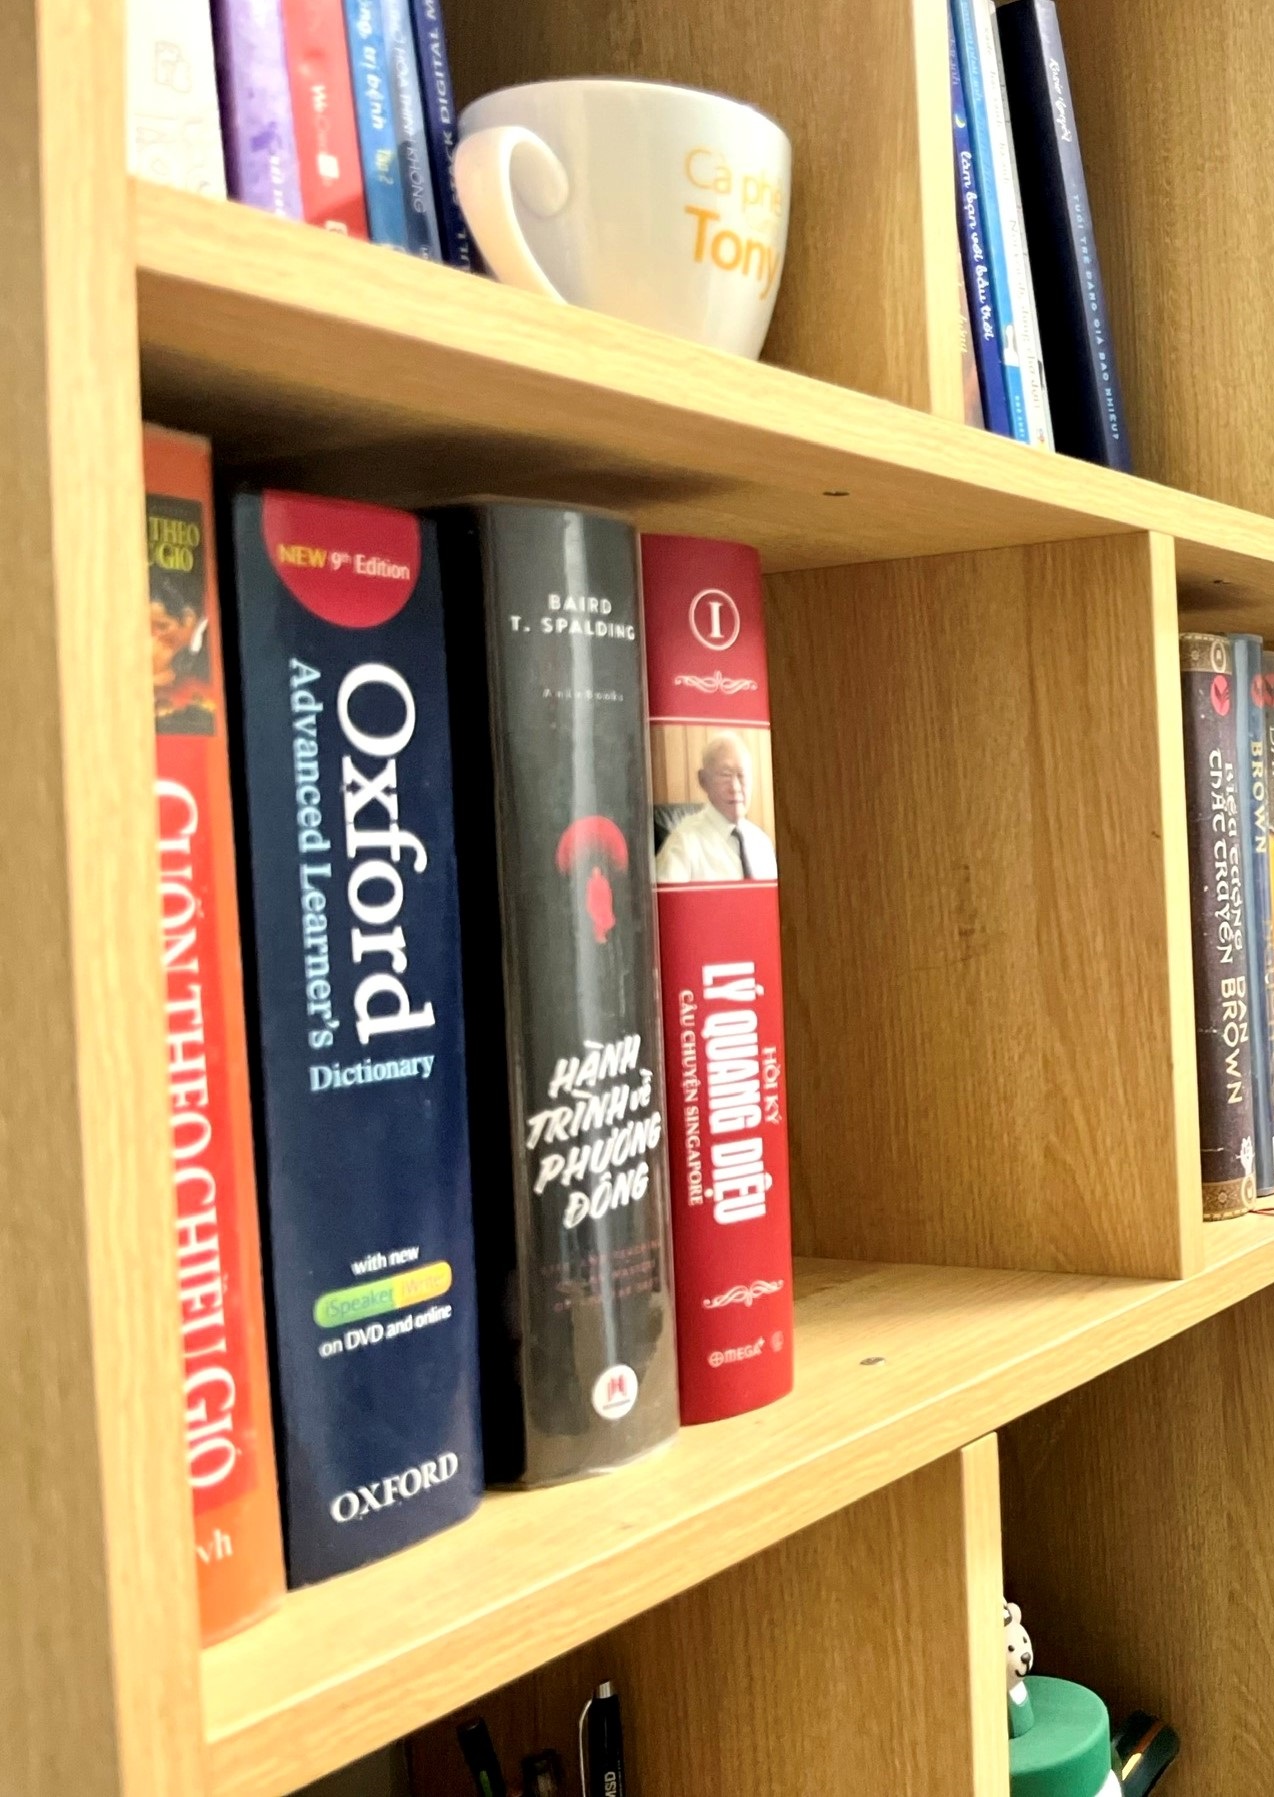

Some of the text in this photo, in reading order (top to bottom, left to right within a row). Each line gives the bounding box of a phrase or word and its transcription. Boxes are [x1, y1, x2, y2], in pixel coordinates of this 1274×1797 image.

[429, 28, 452, 124] DIGITAL
[407, 147, 427, 213] KHÔNG
[960, 151, 973, 189] làm
[963, 191, 979, 229] bạn
[684, 204, 780, 302] Tony
[1098, 352, 1110, 382] BAO
[279, 542, 327, 571] NEW
[354, 554, 411, 582] Edition
[510, 615, 636, 641] T. SPALDING
[547, 593, 613, 615] BAIRD
[289, 656, 333, 853] Advanced
[1248, 740, 1270, 855] BROWN
[337, 661, 437, 1045] Oxford
[1219, 978, 1244, 1105] BROWN
[1235, 976, 1250, 1043] DAN
[307, 1053, 436, 1093] Dictionary
[547, 1033, 642, 1098] HÀNH
[678, 989, 704, 1208] CÂU CHUYỆN SINGAPORE
[700, 959, 774, 1227] LÝ QUANG DIỆU
[526, 1086, 633, 1150] TRÌNH
[532, 1111, 662, 1195] PHƯƠNG
[562, 1162, 649, 1230] ĐÔNG
[351, 1246, 420, 1276] with new
[319, 1304, 453, 1358] on DVD and online
[330, 1451, 459, 1525] OXFORD
